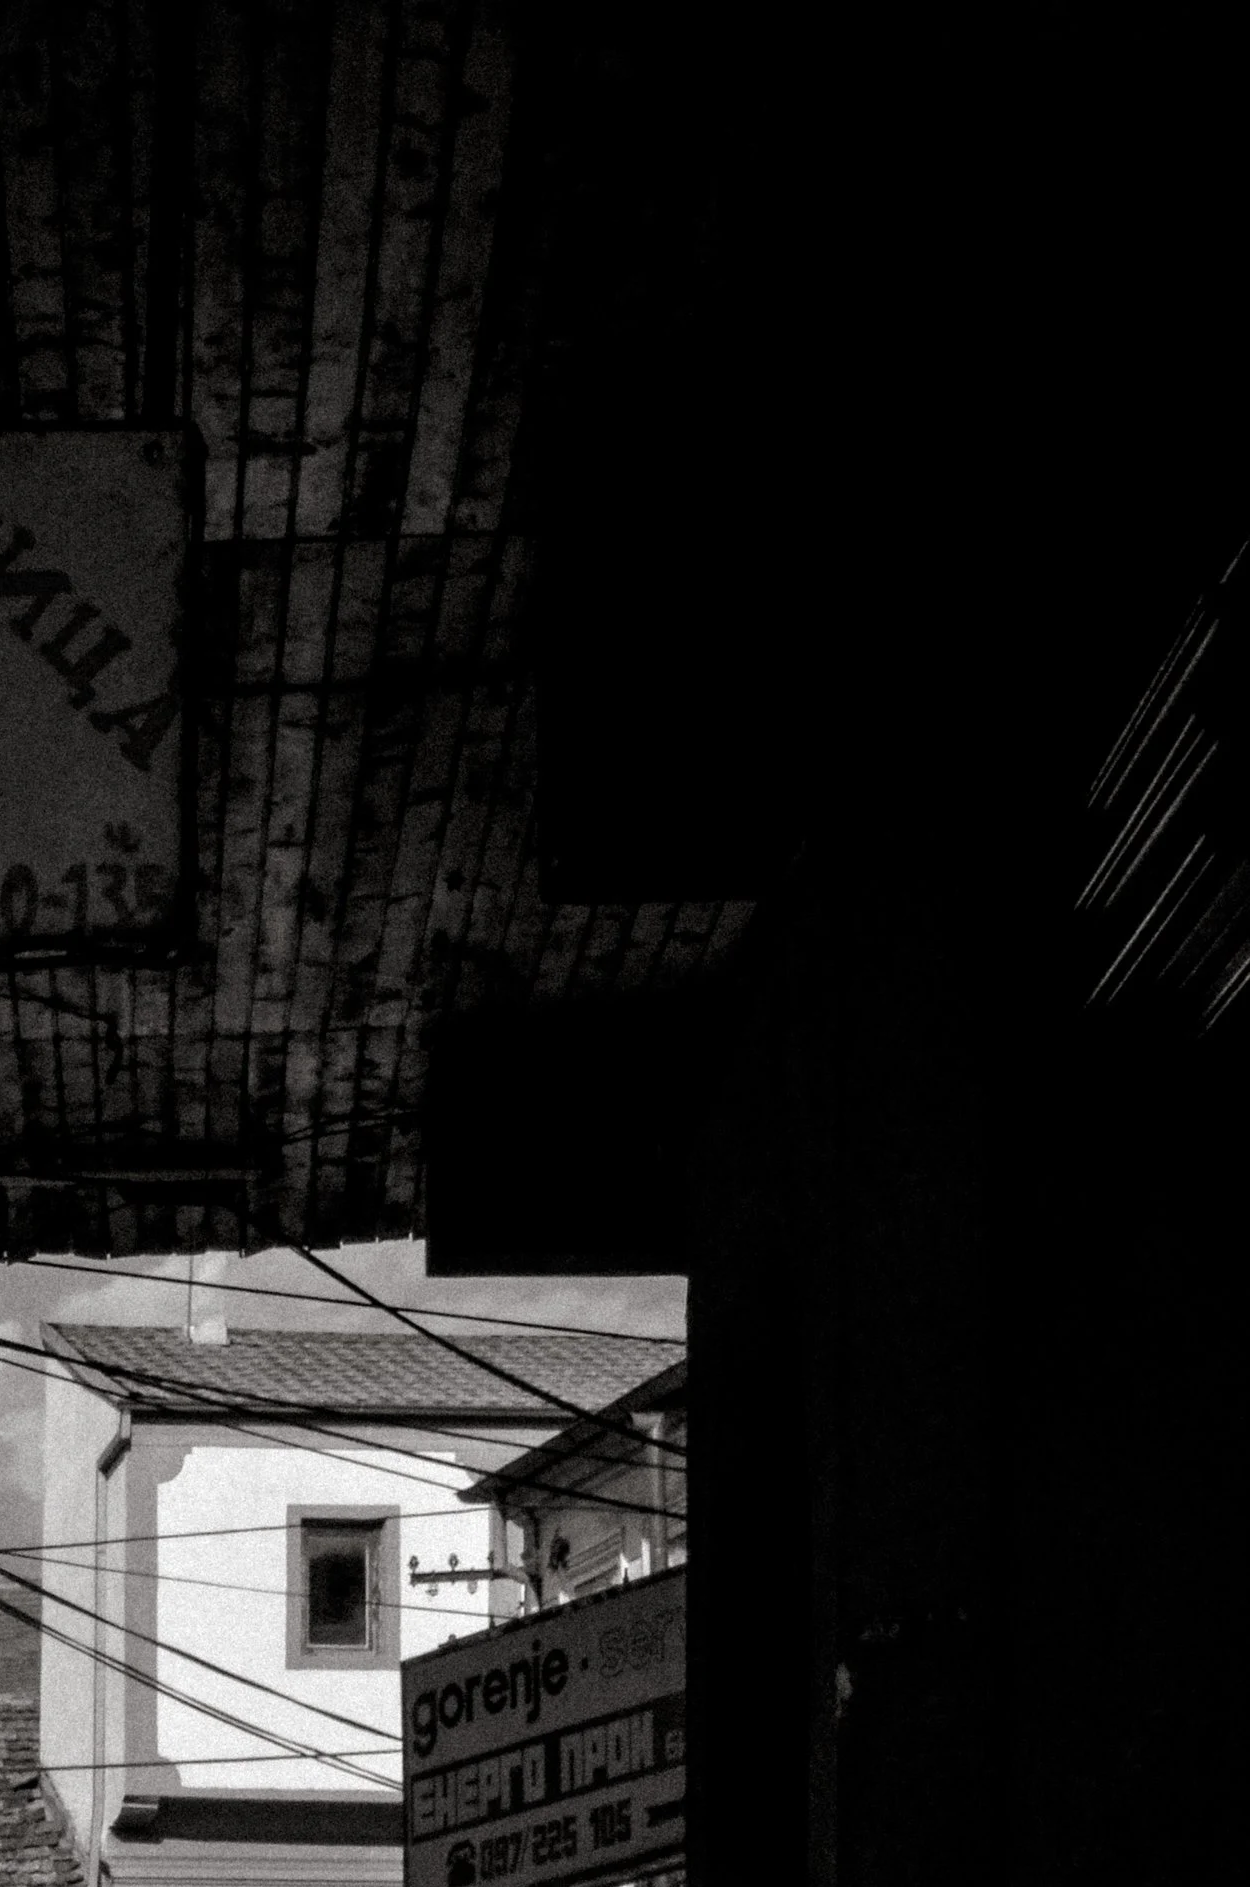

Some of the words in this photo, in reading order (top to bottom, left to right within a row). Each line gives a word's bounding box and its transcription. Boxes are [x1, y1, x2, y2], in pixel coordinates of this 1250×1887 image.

[411, 1638, 568, 1758] gorenje
[411, 1743, 547, 1838] ЕНЕРГО
[589, 1797, 632, 1850] 105
